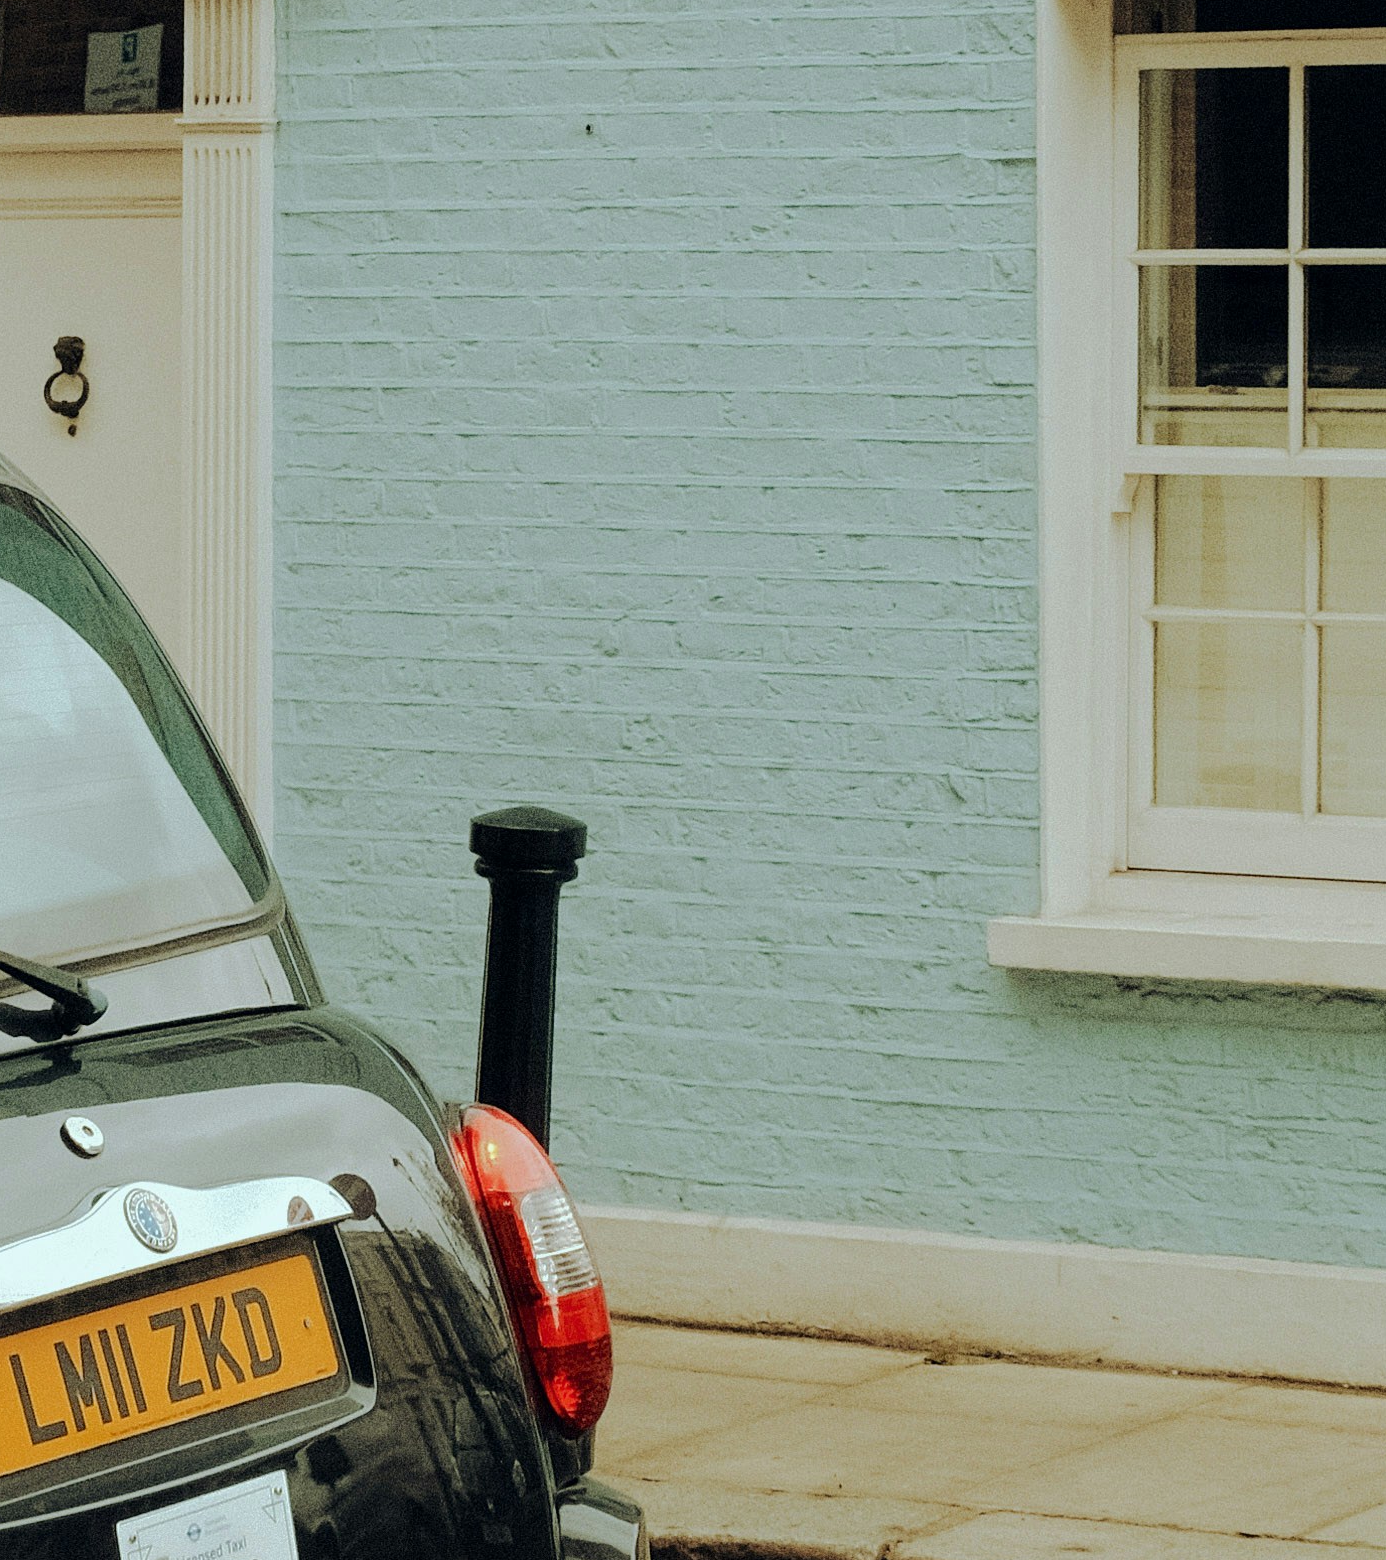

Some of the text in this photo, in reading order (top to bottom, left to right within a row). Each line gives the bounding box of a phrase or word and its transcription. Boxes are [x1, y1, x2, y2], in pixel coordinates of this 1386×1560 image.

[9, 1287, 282, 1445] LM11 ZKD
[226, 1535, 248, 1555] Taxi
